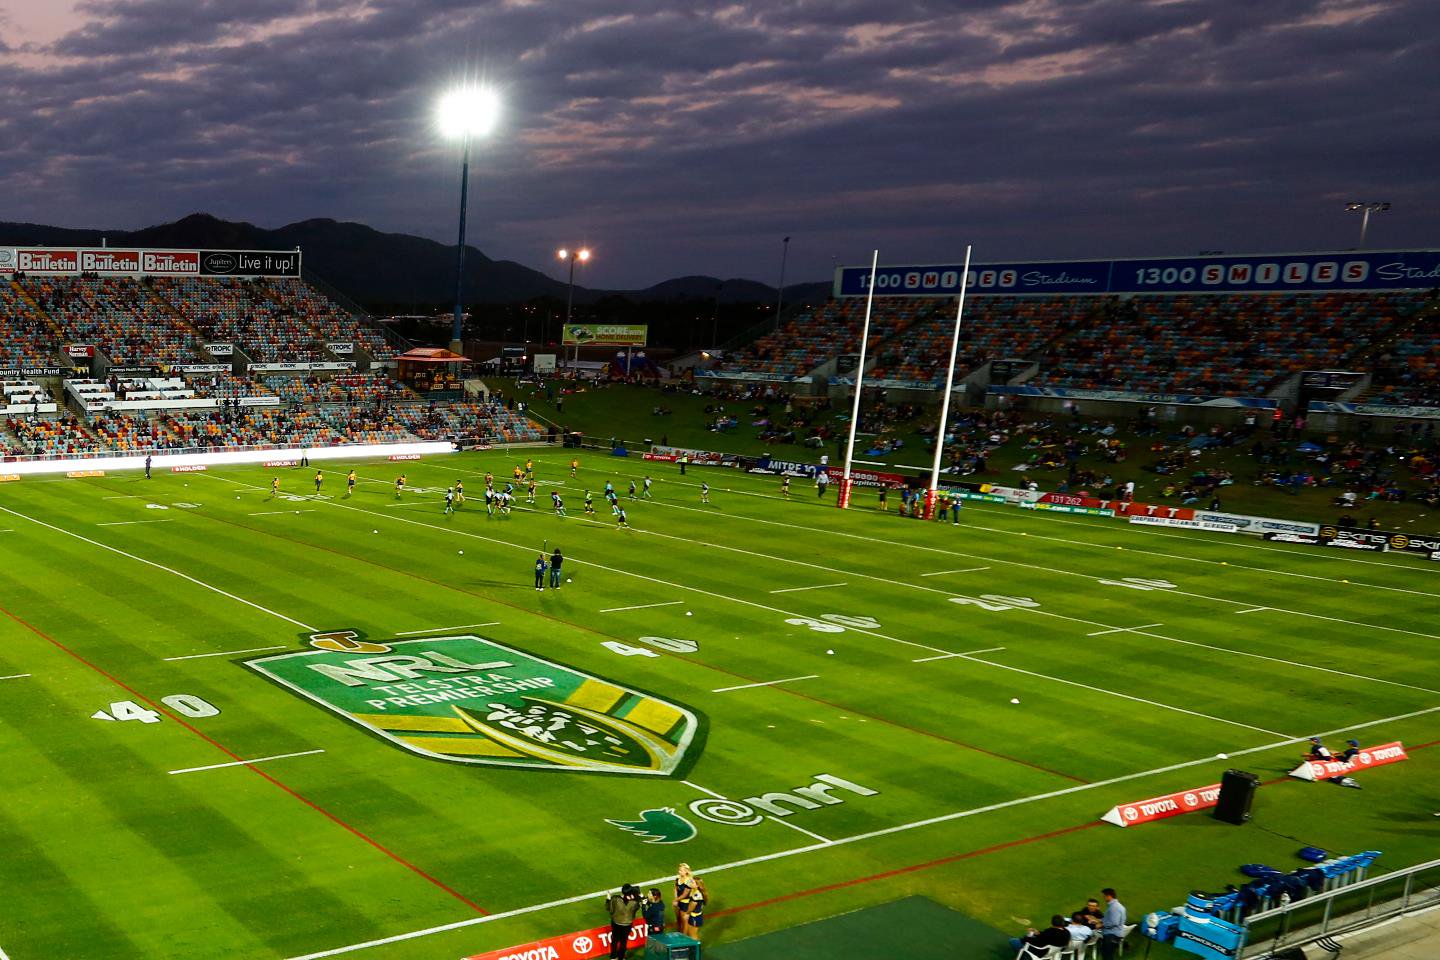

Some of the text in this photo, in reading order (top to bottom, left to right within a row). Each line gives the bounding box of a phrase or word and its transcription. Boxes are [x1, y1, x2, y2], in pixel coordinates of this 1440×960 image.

[19, 252, 76, 271] Bulletin
[83, 253, 138, 271] Bulletin
[144, 254, 197, 272] Bulletin
[208, 258, 233, 267] Jupiters
[239, 254, 294, 273] Live it up!
[1021, 271, 1098, 286] Stadium
[1136, 267, 1196, 285] 1300
[1201, 261, 1369, 285] SMILES
[768, 460, 802, 472] MITRE
[804, 464, 817, 474] 10
[1050, 494, 1082, 506] 131 262
[306, 650, 515, 687] NRL
[364, 675, 557, 711] PREMIERSHIP
[371, 672, 514, 697] TELSTRA
[1371, 745, 1403, 761] TOYOTA
[688, 773, 880, 826] @nrl
[1199, 787, 1221, 803] TOY
[1139, 798, 1178, 817] TOYOTA
[1181, 931, 1227, 955] POWERADE
